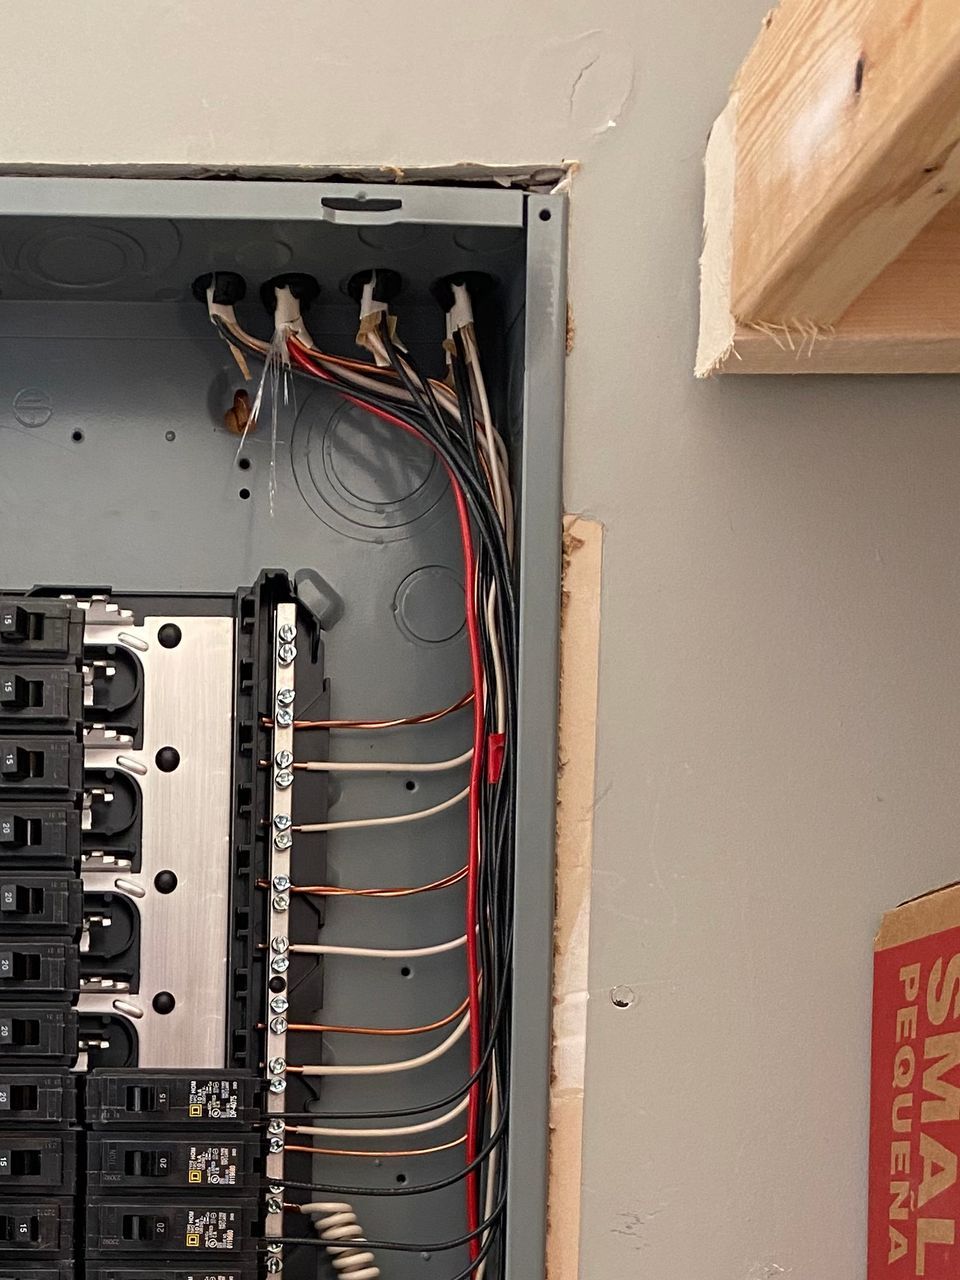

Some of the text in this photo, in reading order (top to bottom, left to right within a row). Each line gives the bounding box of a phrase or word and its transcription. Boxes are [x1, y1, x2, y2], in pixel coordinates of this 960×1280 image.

[5, 615, 11, 624] 15
[5, 682, 12, 692] 15
[6, 755, 13, 764] 15
[3, 823, 9, 833] 20
[5, 892, 12, 902] 20
[2, 960, 8, 970] 20
[1, 1026, 8, 1036] 20
[0, 1092, 6, 1102] 20
[160, 1094, 166, 1103] 15
[888, 962, 921, 1265] PEQUEÑA
[0, 1157, 7, 1166] 15
[160, 1158, 167, 1168] 20
[20, 1223, 27, 1232] 15
[157, 1223, 164, 1232] 20
